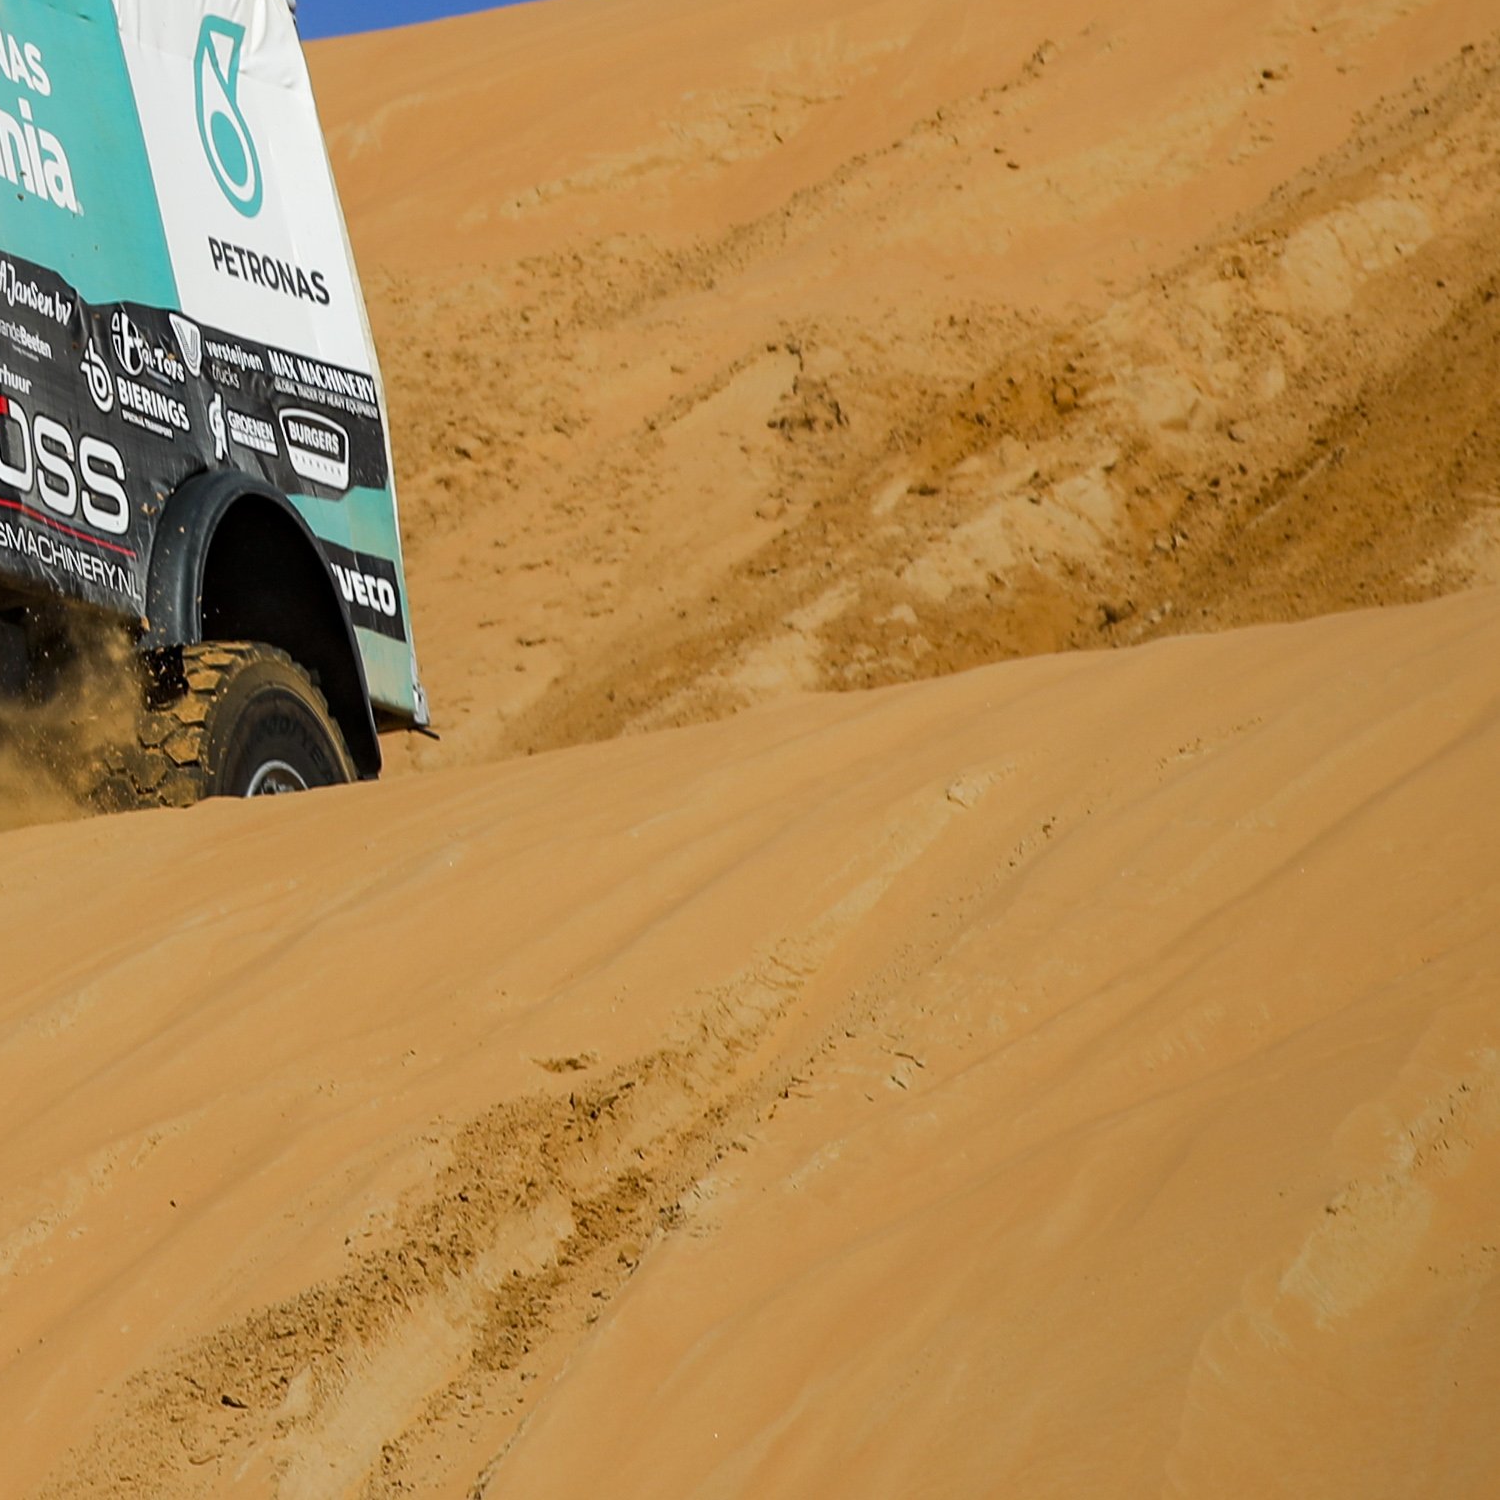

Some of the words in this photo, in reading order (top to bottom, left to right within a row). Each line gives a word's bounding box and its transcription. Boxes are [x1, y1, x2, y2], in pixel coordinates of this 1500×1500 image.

[208, 236, 331, 306] PETRONAS
[212, 363, 241, 389] trucks
[267, 350, 299, 381] MAX
[297, 358, 377, 404] MACHINERY
[116, 375, 191, 432] BIERINGS
[227, 410, 274, 442] GROENEN
[288, 420, 340, 455] BURGERS
